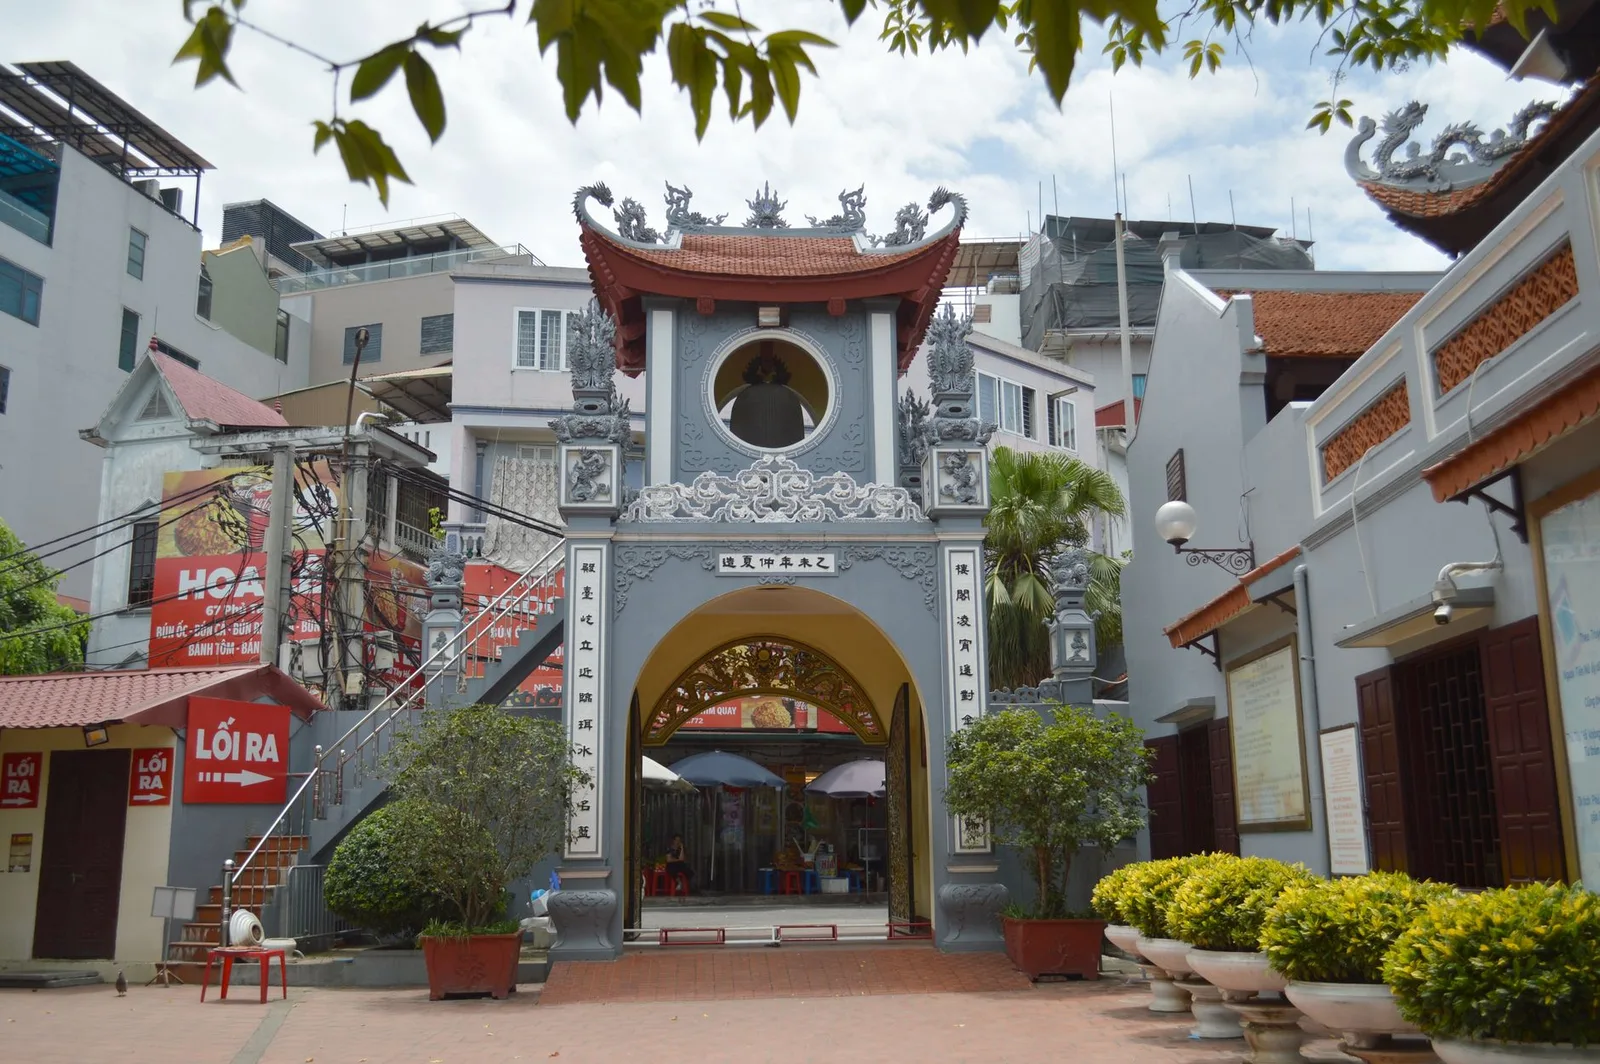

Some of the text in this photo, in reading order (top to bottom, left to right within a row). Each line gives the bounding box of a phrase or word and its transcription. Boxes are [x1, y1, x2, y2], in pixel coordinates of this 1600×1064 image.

[178, 566, 264, 600] HOA
[206, 605, 221, 616] 67
[156, 622, 175, 639] BÚN
[233, 618, 251, 636] BÚN
[215, 638, 235, 656] TÔM
[717, 706, 737, 716] QUAY
[195, 716, 280, 763] LỐI RA
[8, 756, 35, 777] LỐI
[139, 751, 167, 773] LỐI
[8, 779, 31, 794] RA
[139, 775, 163, 790] RA
